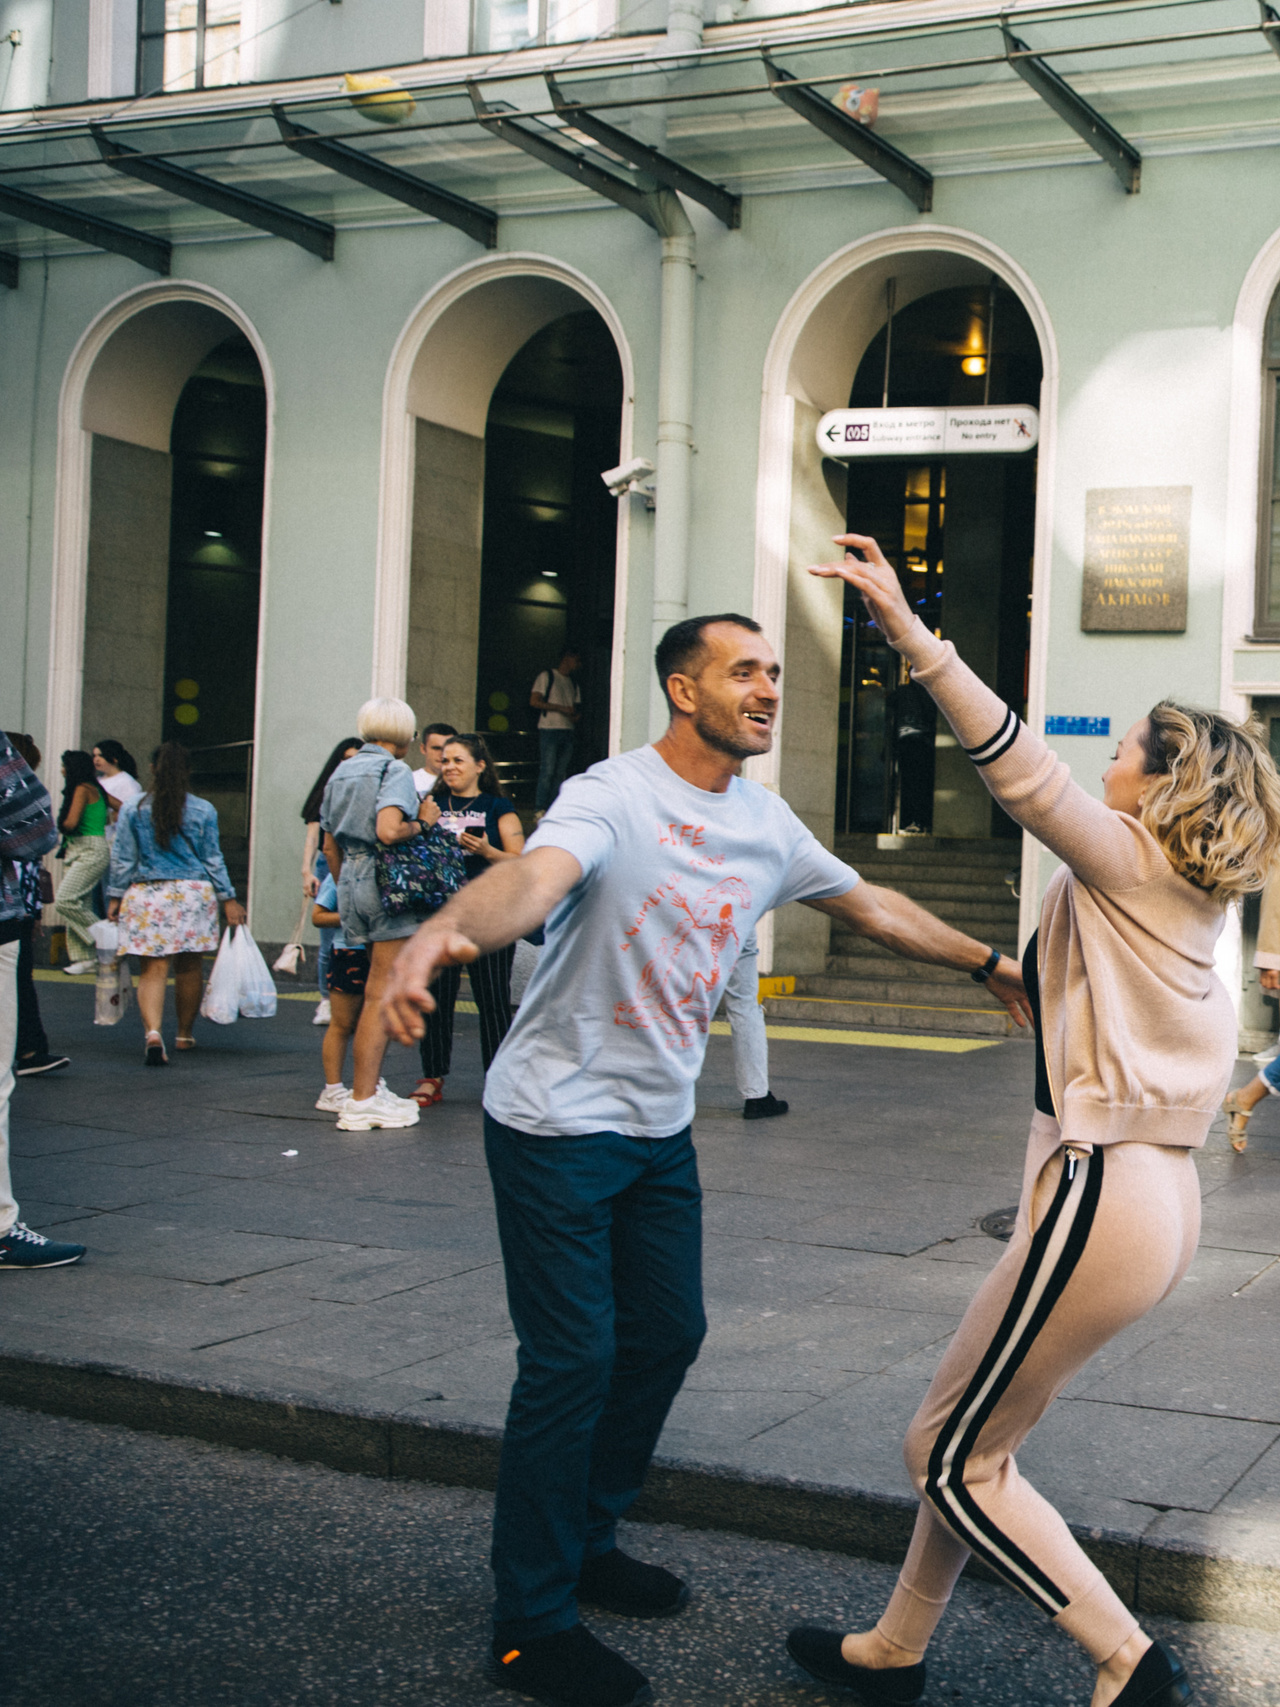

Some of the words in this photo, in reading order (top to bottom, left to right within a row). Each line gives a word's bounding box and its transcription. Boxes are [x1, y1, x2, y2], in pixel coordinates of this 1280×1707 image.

[950, 417, 992, 428] Прохода
[994, 418, 1011, 426] нет
[961, 431, 974, 441] No
[975, 431, 998, 442] entry
[1097, 592, 1171, 607] АКИМОВ
[656, 822, 706, 848] LIFE
